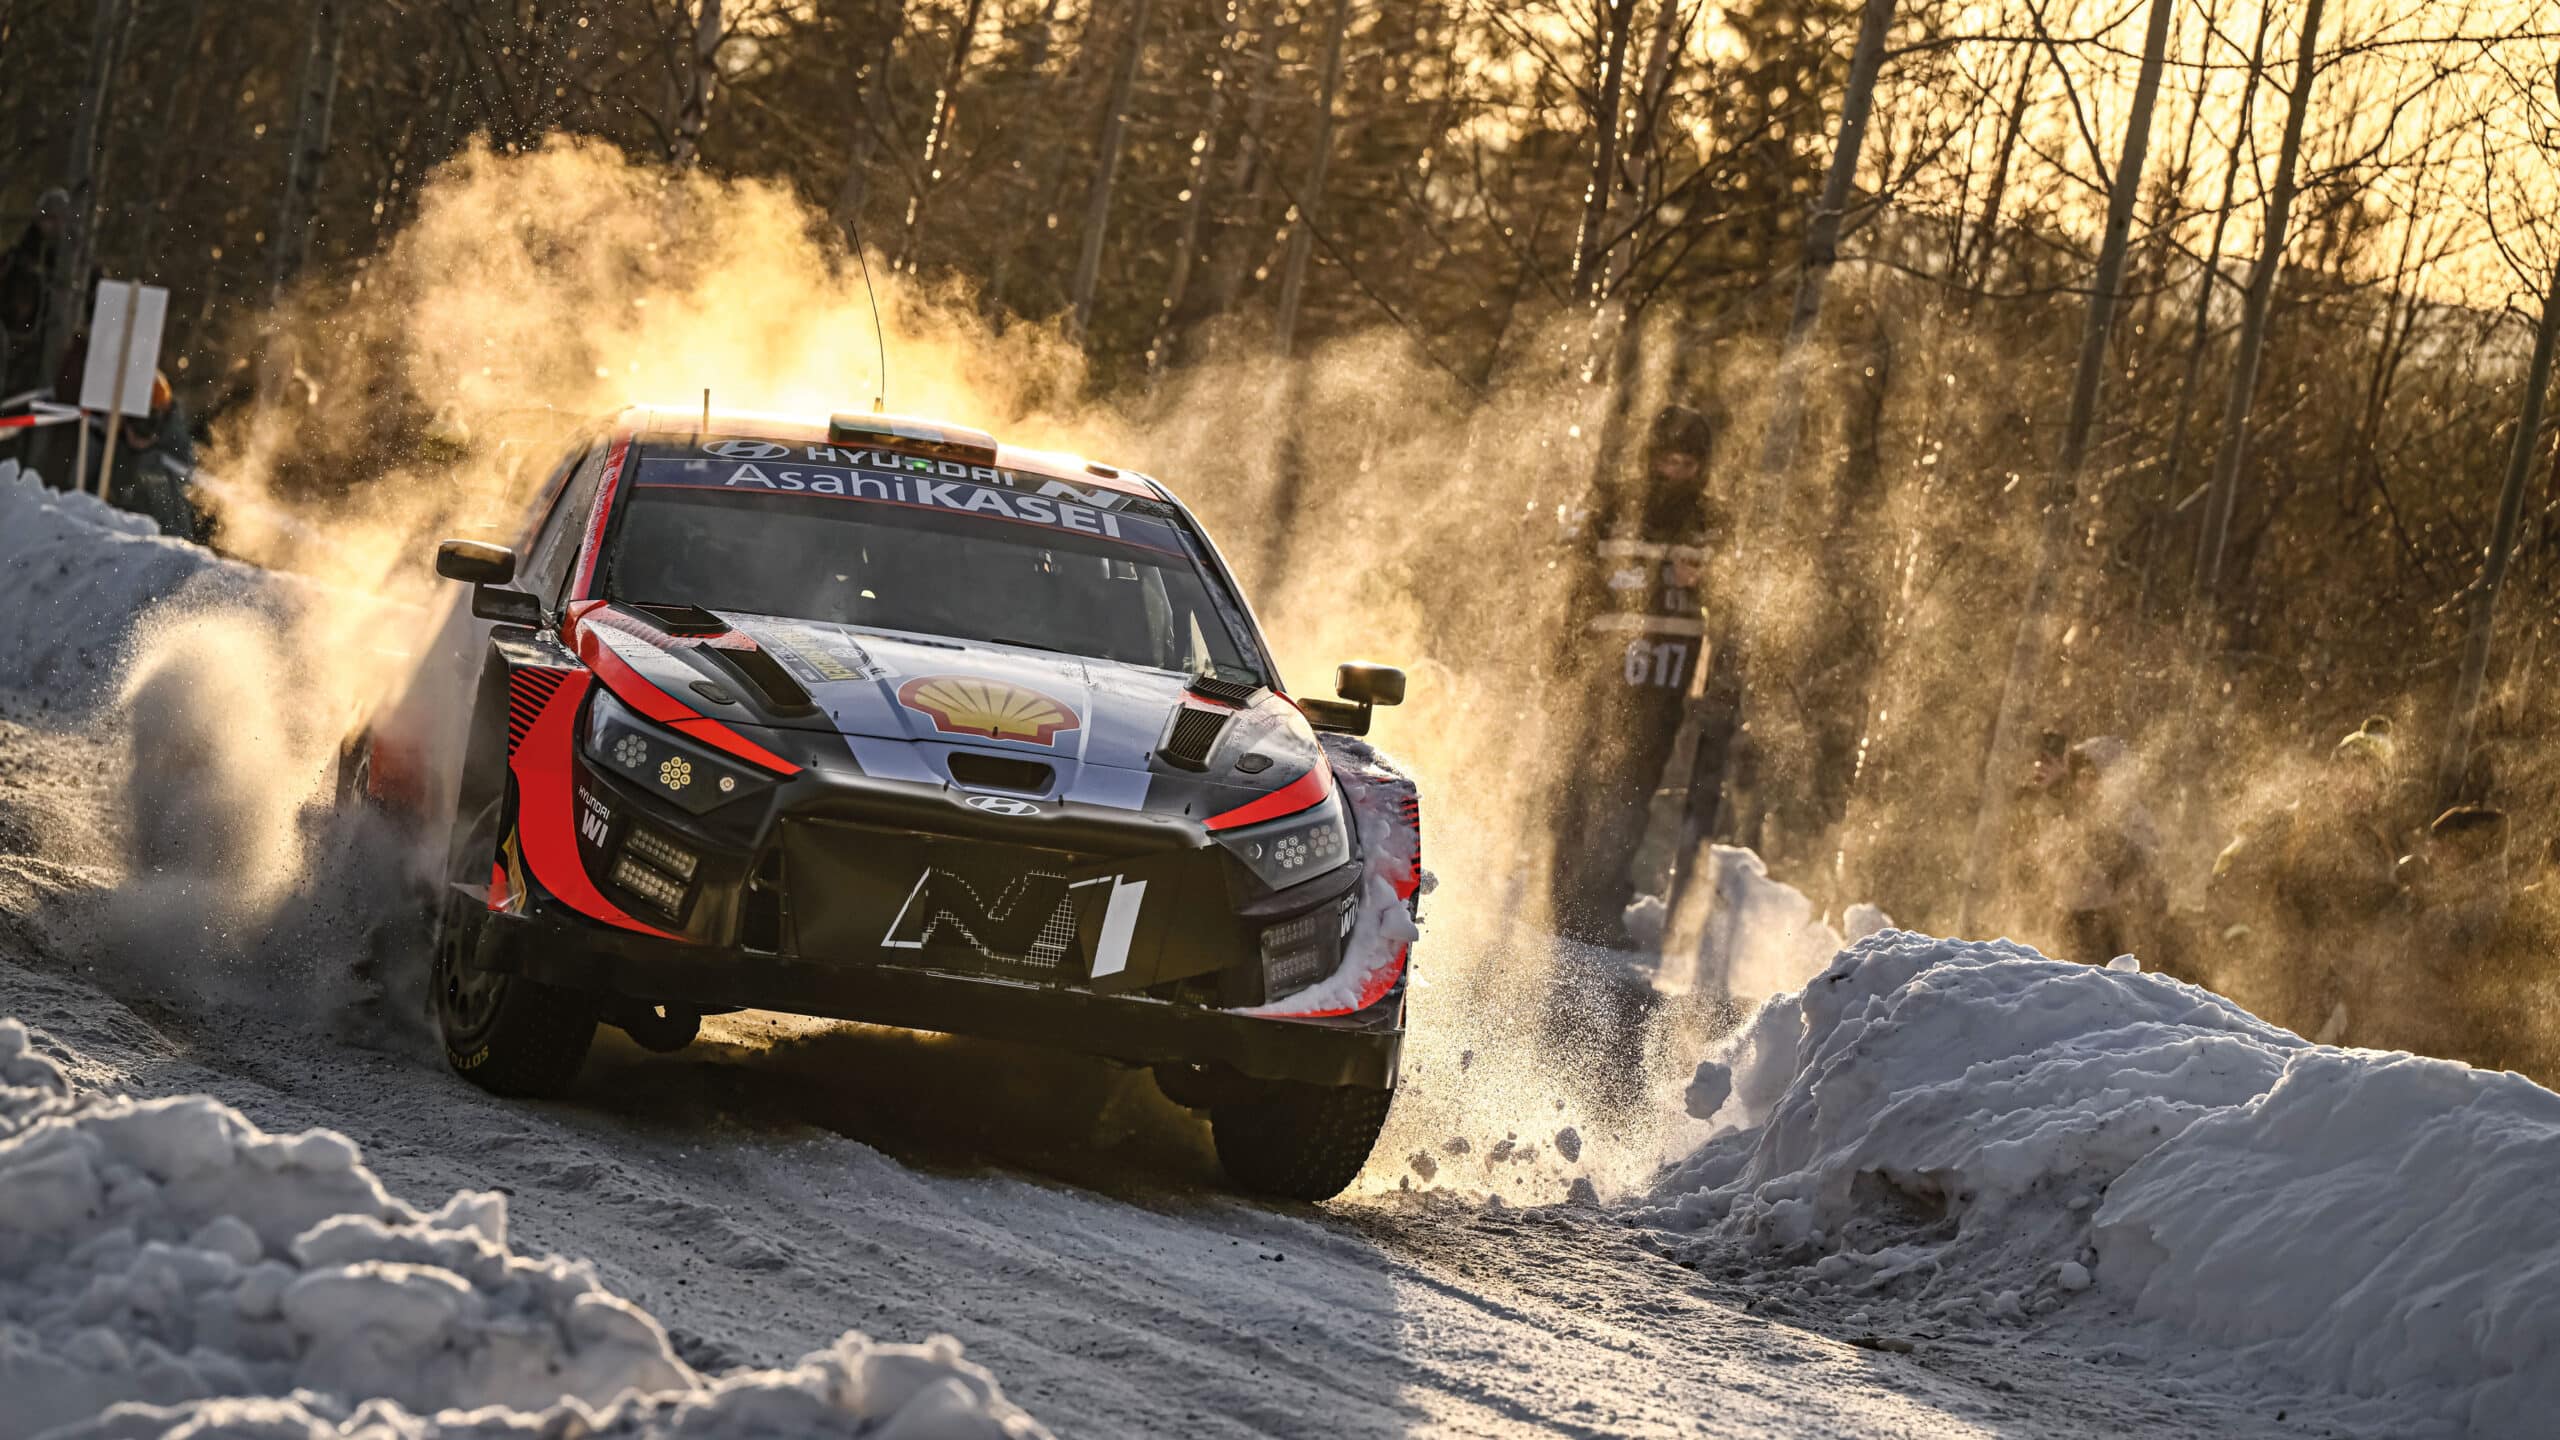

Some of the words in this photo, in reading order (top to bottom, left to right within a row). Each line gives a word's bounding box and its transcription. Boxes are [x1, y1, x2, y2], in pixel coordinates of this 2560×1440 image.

[806, 446, 1015, 487] HYUNDAI
[1624, 640, 1687, 688] 617
[578, 784, 610, 820] HYUNDAI
